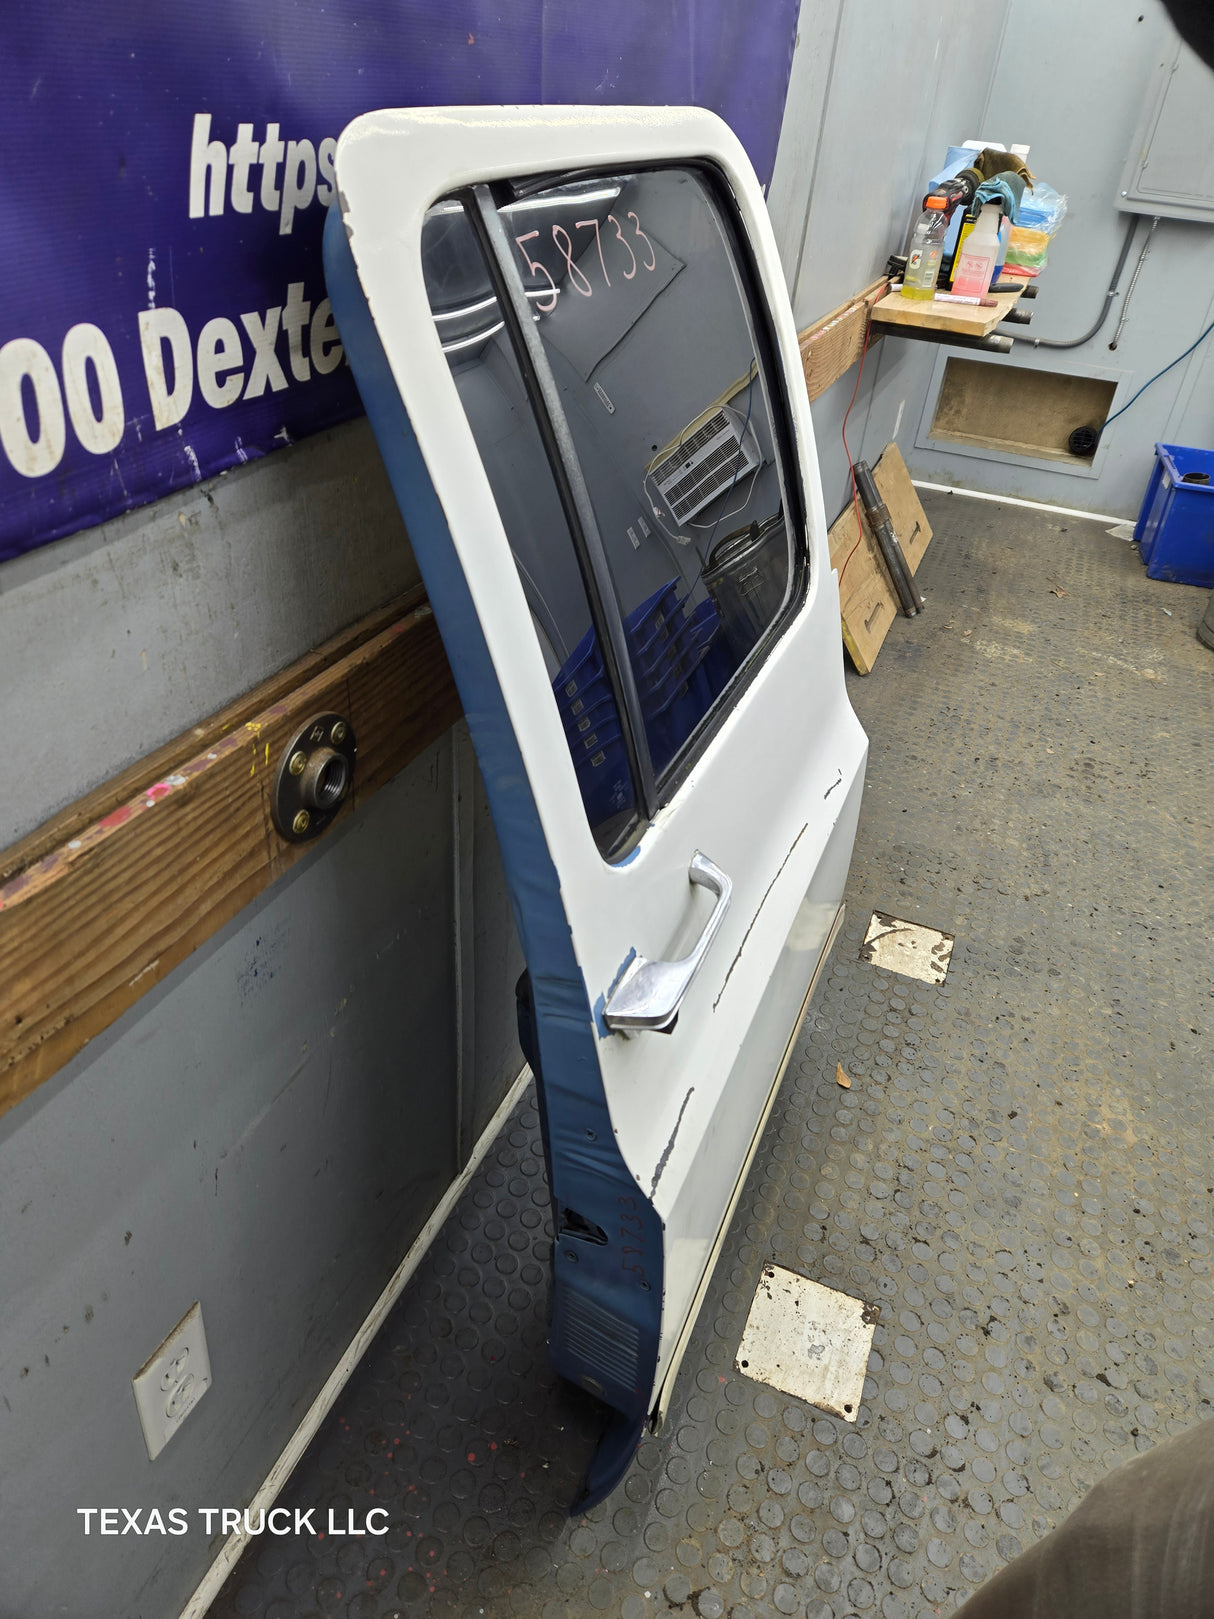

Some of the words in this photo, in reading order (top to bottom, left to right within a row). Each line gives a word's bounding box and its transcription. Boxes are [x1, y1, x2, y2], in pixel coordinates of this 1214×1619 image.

[189, 113, 338, 235] https
[515, 211, 656, 312] 58733
[138, 282, 348, 431] Dexte
